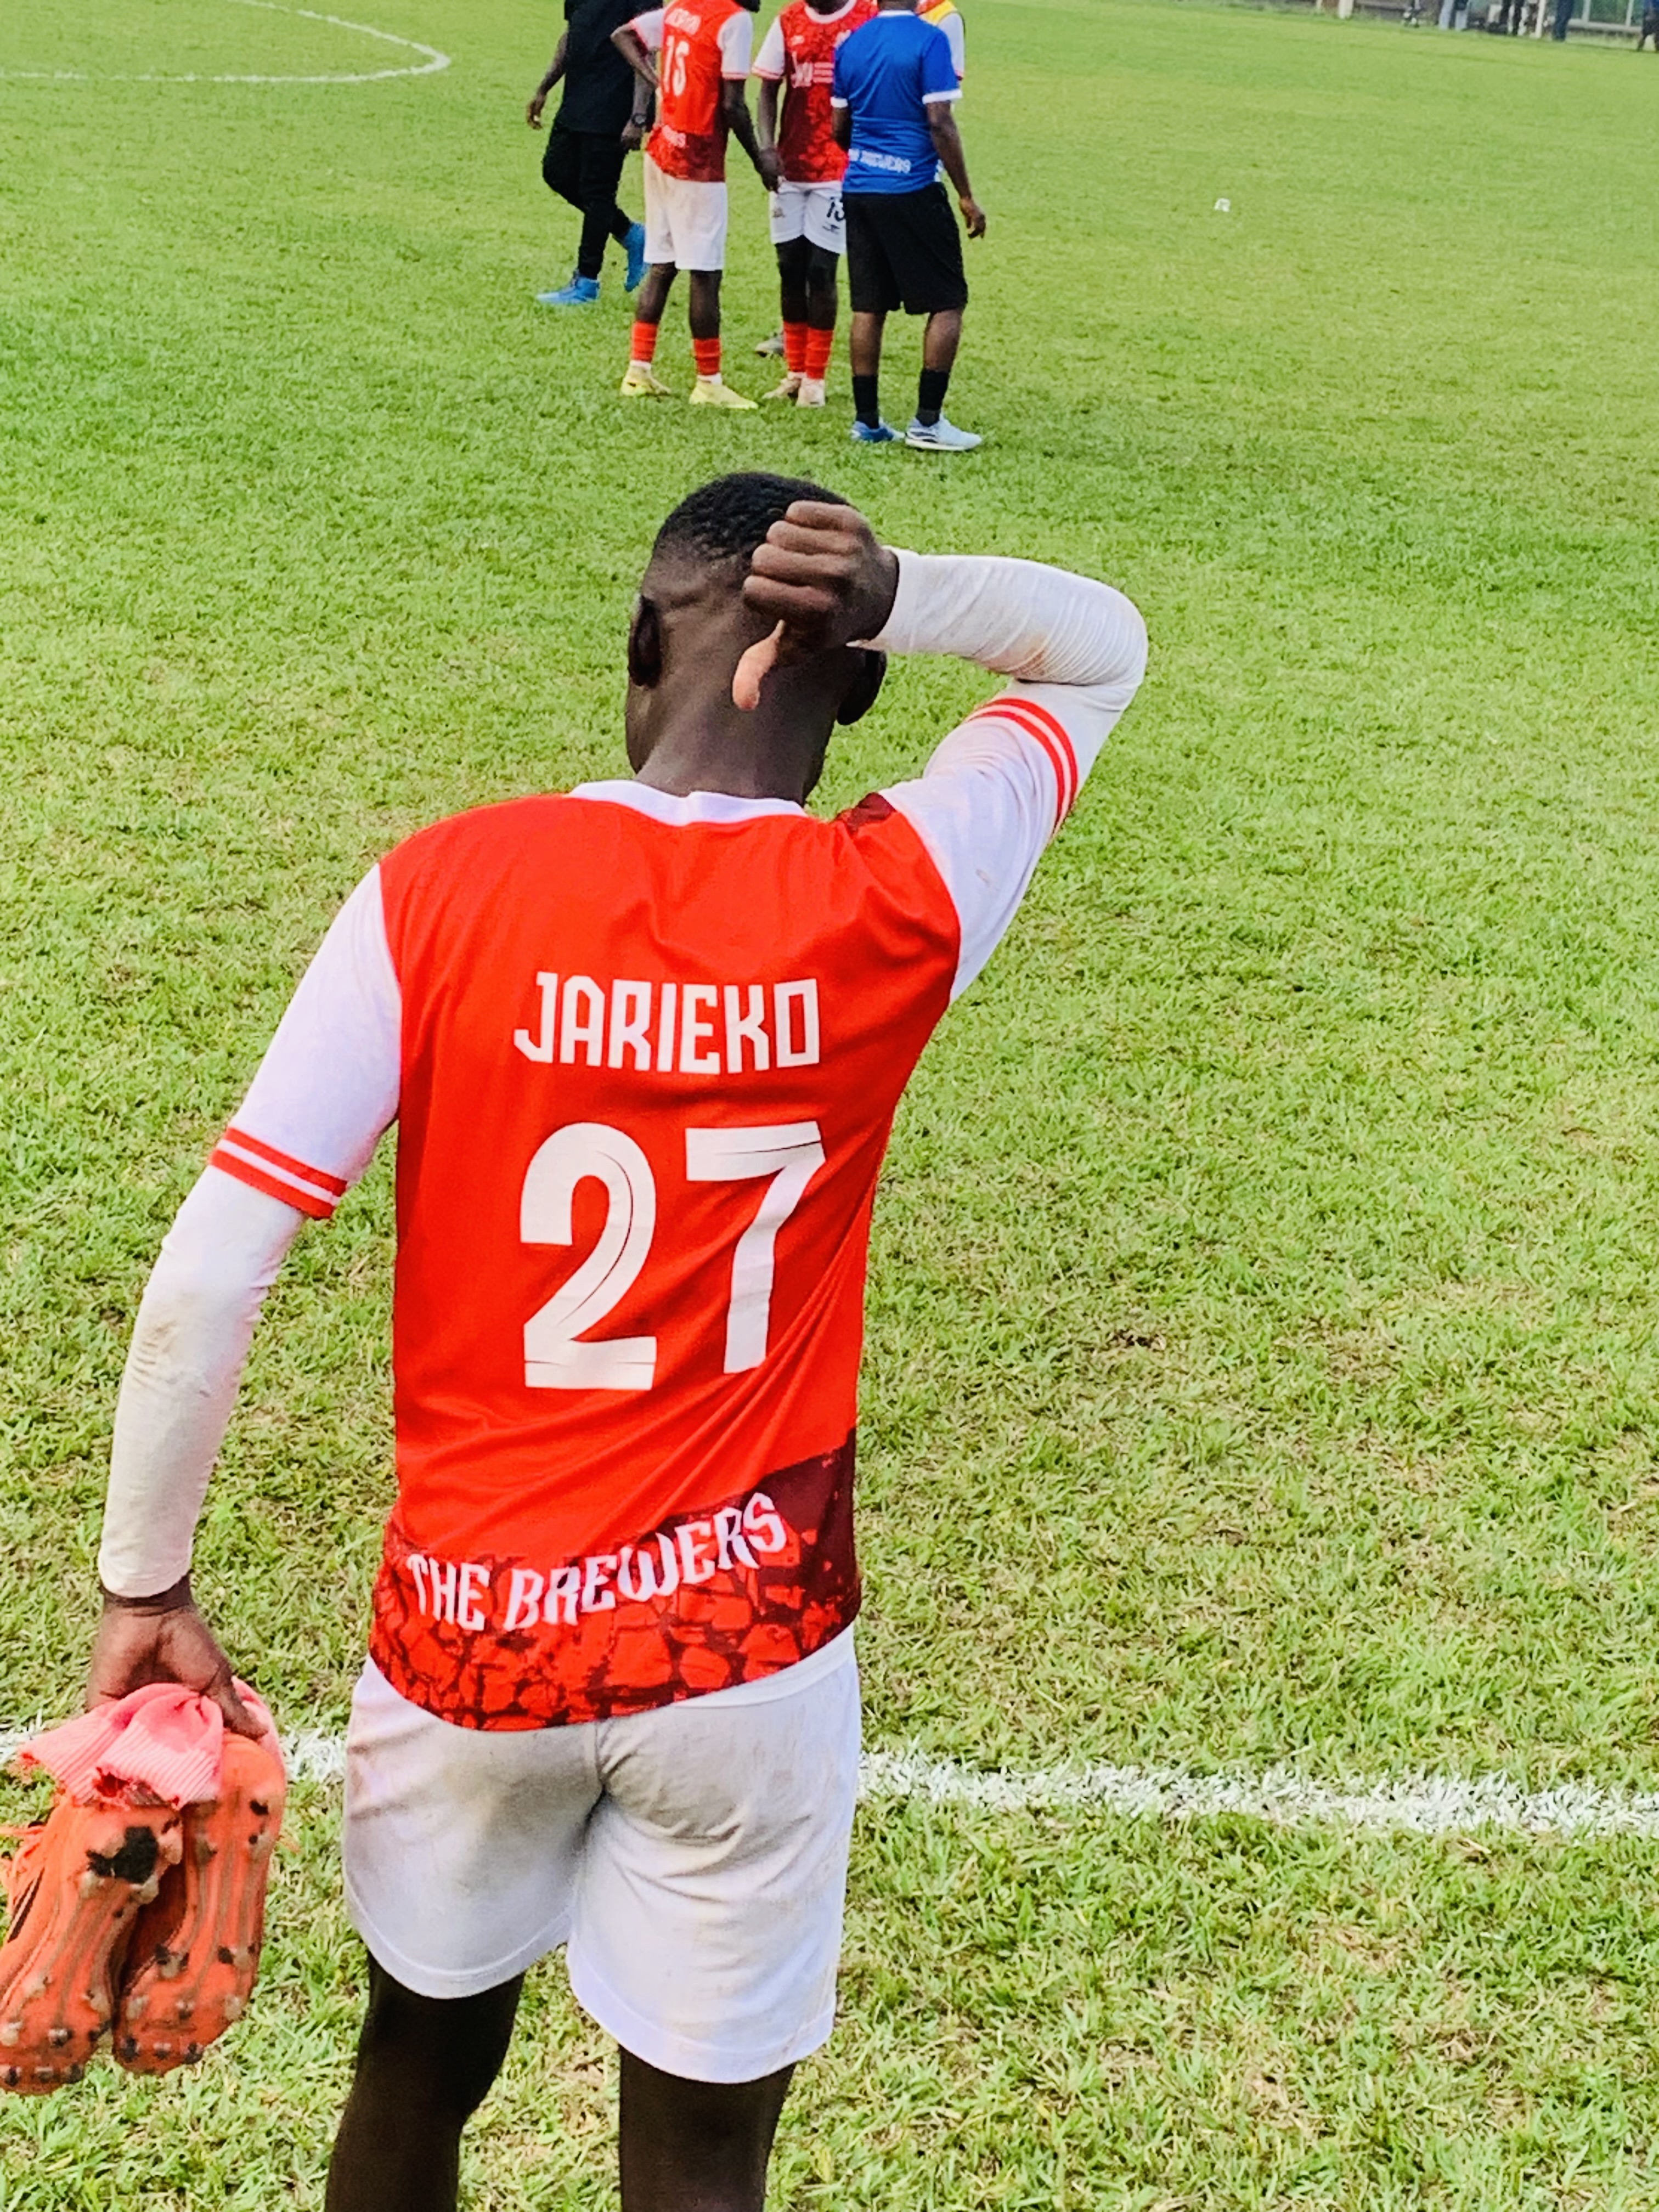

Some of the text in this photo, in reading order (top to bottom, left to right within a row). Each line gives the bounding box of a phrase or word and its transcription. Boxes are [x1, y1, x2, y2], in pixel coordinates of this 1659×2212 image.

[514, 971, 820, 1075] JARIEKO
[520, 1122, 826, 1390] 27
[407, 1493, 787, 1631] THE BREWERS
